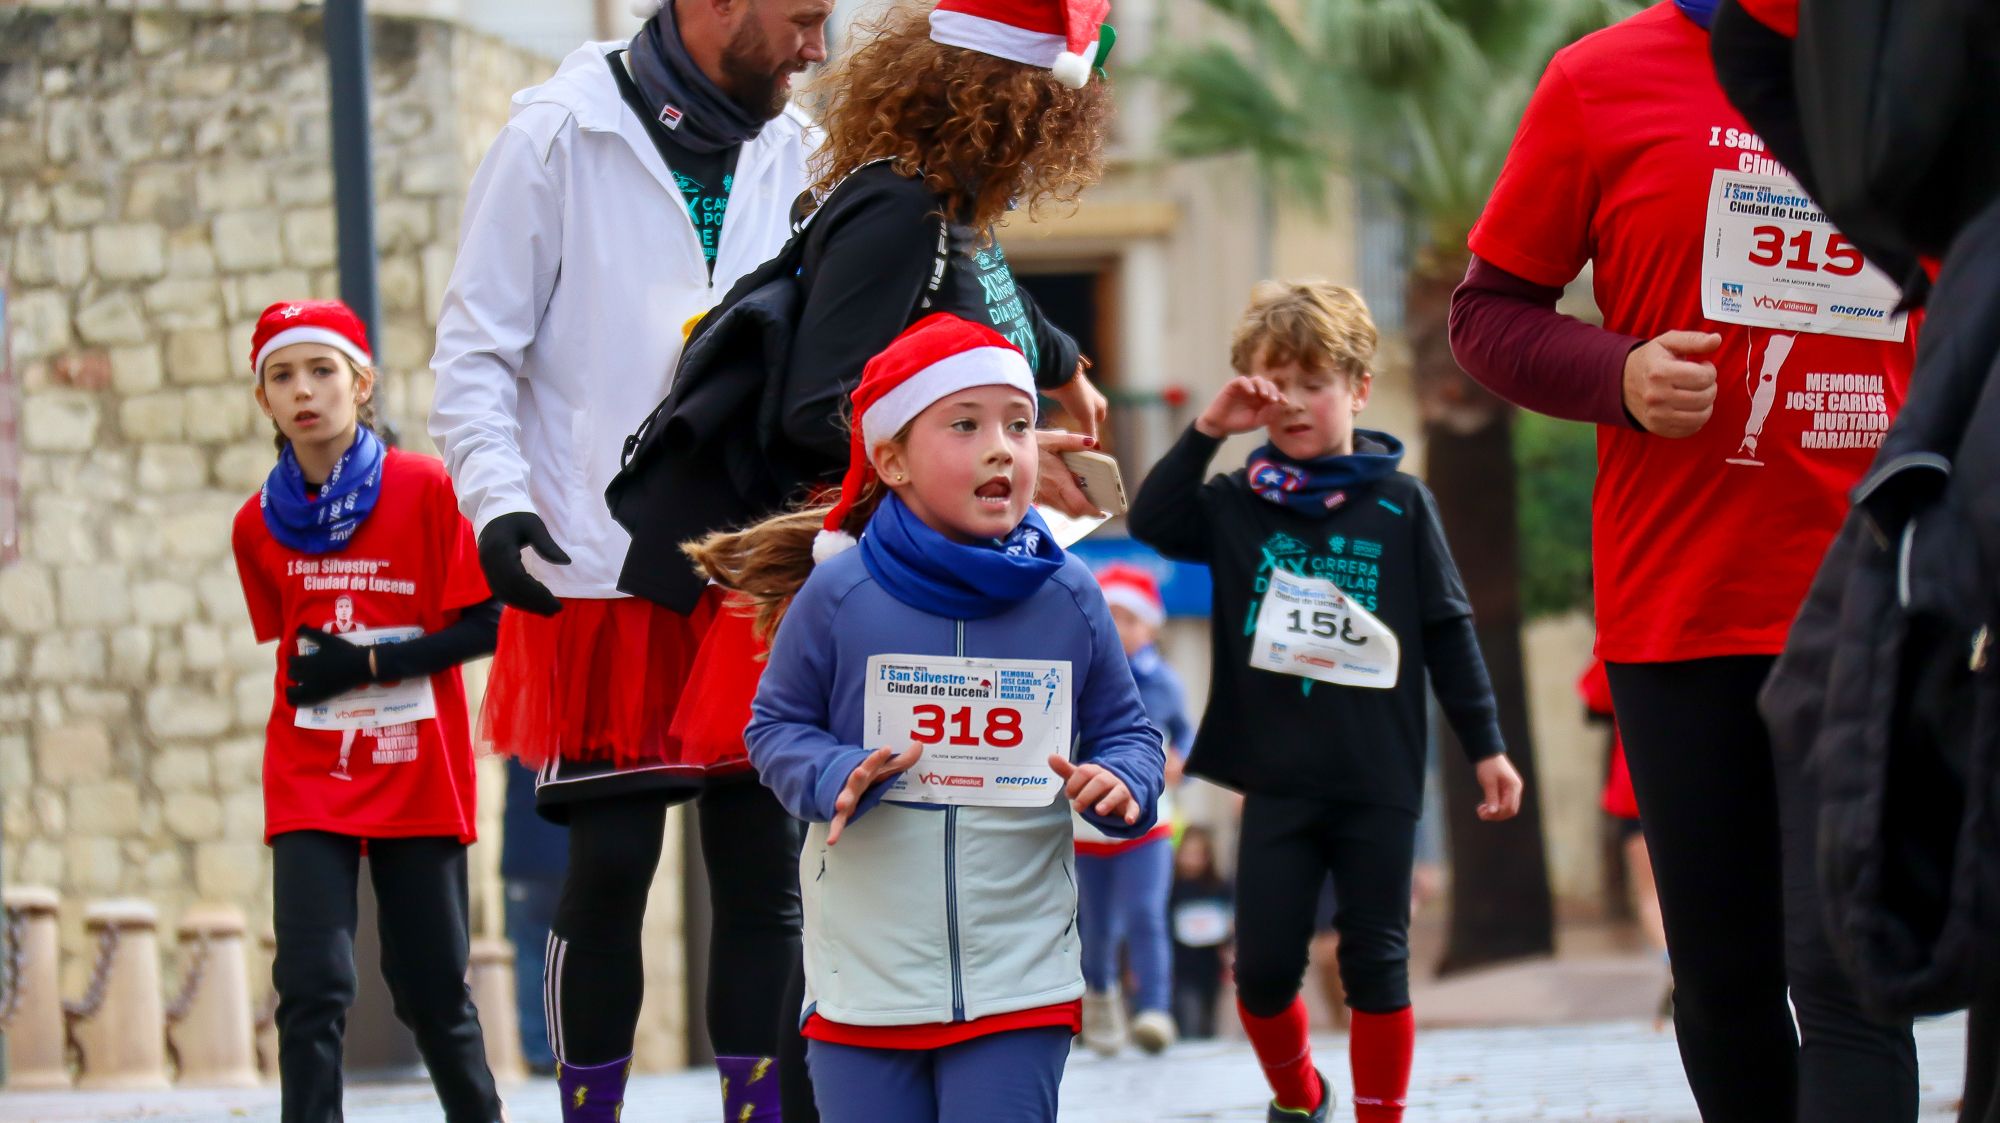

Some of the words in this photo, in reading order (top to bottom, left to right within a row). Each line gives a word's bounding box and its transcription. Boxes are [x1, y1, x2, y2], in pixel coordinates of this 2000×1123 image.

[1708, 126, 1721, 147] I
[1724, 187, 1731, 198] I
[1732, 188, 1754, 201] San
[1756, 191, 1809, 209] Silvestre
[1729, 201, 1769, 217] Ciudad
[1771, 205, 1786, 218] de
[1748, 225, 1865, 277] 315
[1753, 294, 1782, 310] vtv
[1830, 304, 1885, 318] enerplus
[1805, 372, 1885, 394] MEMORIAL
[1785, 391, 1825, 411] JOSE
[1827, 392, 1887, 413] CARLOS
[1813, 412, 1890, 431] HURTADO
[287, 561, 294, 576] I
[295, 560, 320, 575] San
[321, 559, 378, 575] Silvestre
[303, 575, 349, 591] Ciudad
[350, 577, 367, 591] de
[368, 576, 416, 596] Lucena
[880, 669, 886, 681] I
[888, 670, 911, 681] San
[913, 671, 966, 685] Silvestre
[1000, 670, 1034, 679] MEMORIAL
[1000, 678, 1016, 686] JOSE
[1016, 678, 1042, 687] CARLOS
[887, 682, 928, 695] Ciudad
[930, 685, 946, 697] de
[948, 685, 989, 698] Lucena
[1000, 685, 1031, 693] HURTADO
[1000, 693, 1035, 701] MARJALIZO
[910, 704, 1024, 748] 318
[919, 772, 948, 787] vtv
[950, 777, 982, 788] videoluc
[995, 776, 1048, 787] enerplus
